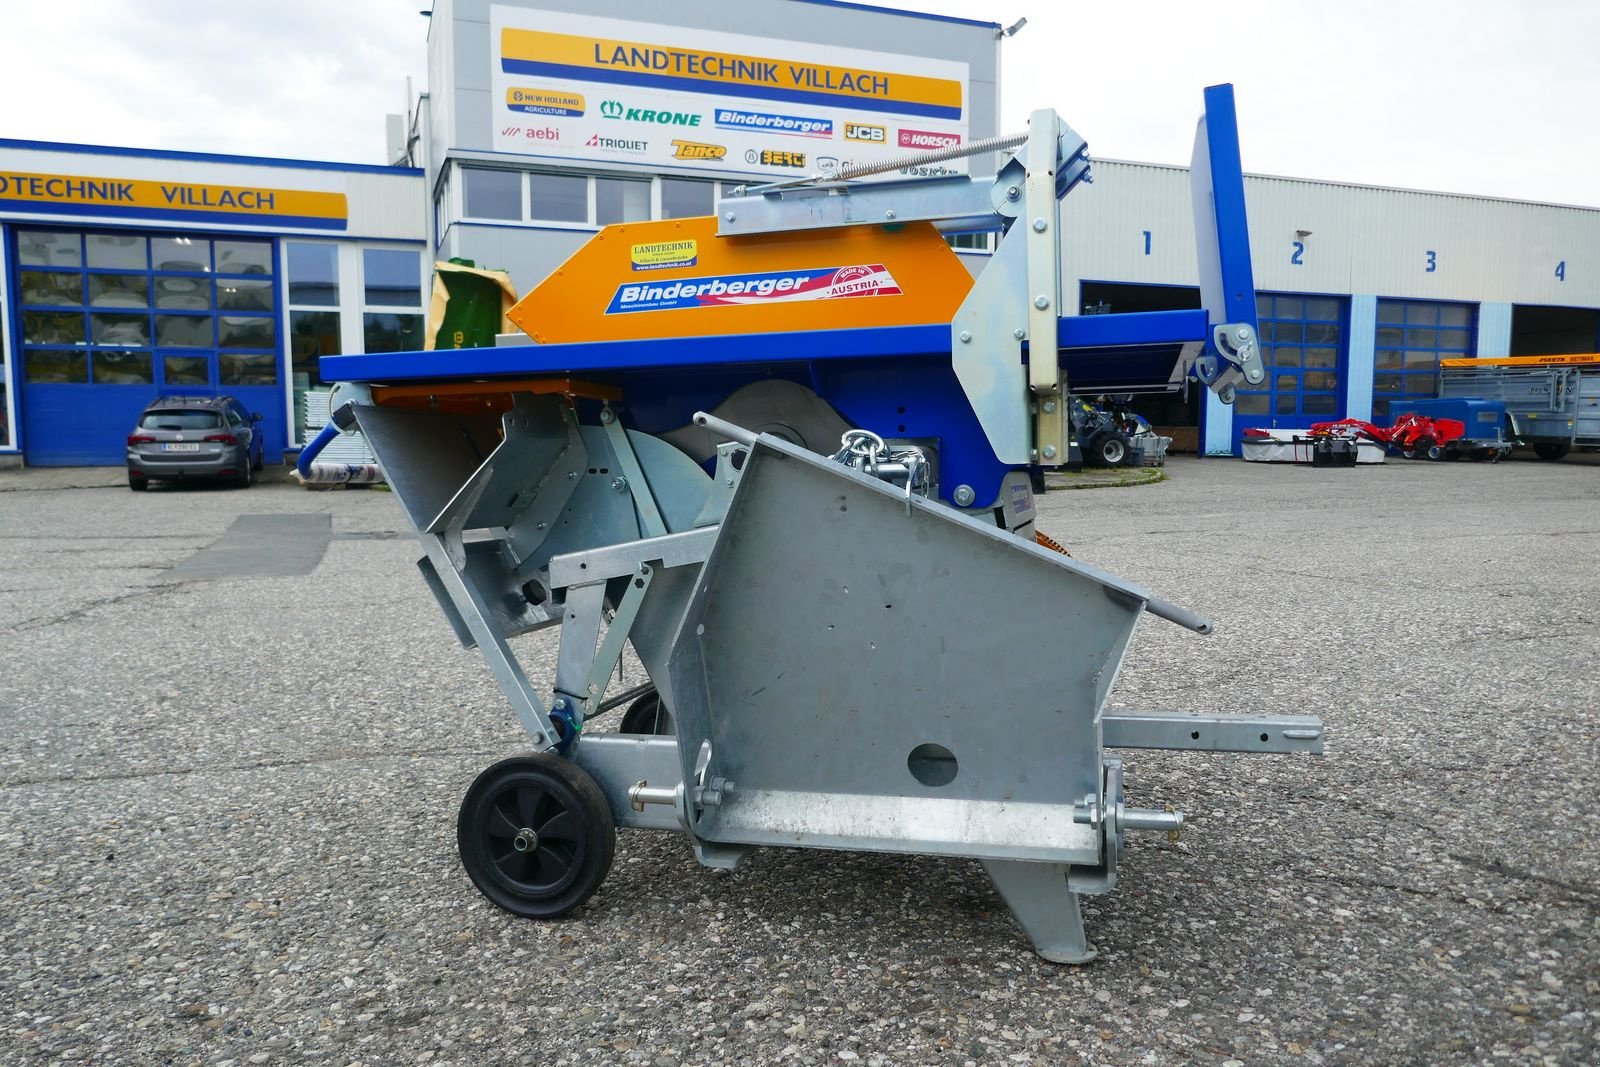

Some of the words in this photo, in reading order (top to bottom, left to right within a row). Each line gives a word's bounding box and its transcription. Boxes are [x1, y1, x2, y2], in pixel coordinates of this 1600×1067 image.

[594, 43, 779, 83] LANDTECHNIK
[788, 66, 889, 95] VILLACH
[524, 94, 543, 103] NEW
[544, 96, 579, 106] HOLLAND
[524, 106, 567, 116] AGRICULTURE
[625, 108, 702, 127] KRONE
[718, 111, 831, 134] Binderberger
[526, 127, 560, 141] aebi
[845, 125, 885, 142] JCB
[911, 134, 958, 149] HORSCH
[598, 138, 648, 151] TRIOLIET
[671, 139, 728, 161] Tanco
[161, 185, 275, 210] VILLACH
[634, 241, 693, 254] LANDTECHNIK
[1142, 230, 1152, 255] 1
[1290, 241, 1305, 265] 2
[1425, 250, 1437, 273] 3
[636, 261, 692, 271] www.landtechnik.co.at
[840, 268, 857, 279] MADE
[1554, 260, 1566, 282] 4
[620, 275, 810, 304] Binderberger
[831, 279, 879, 295] AUSTRIA
